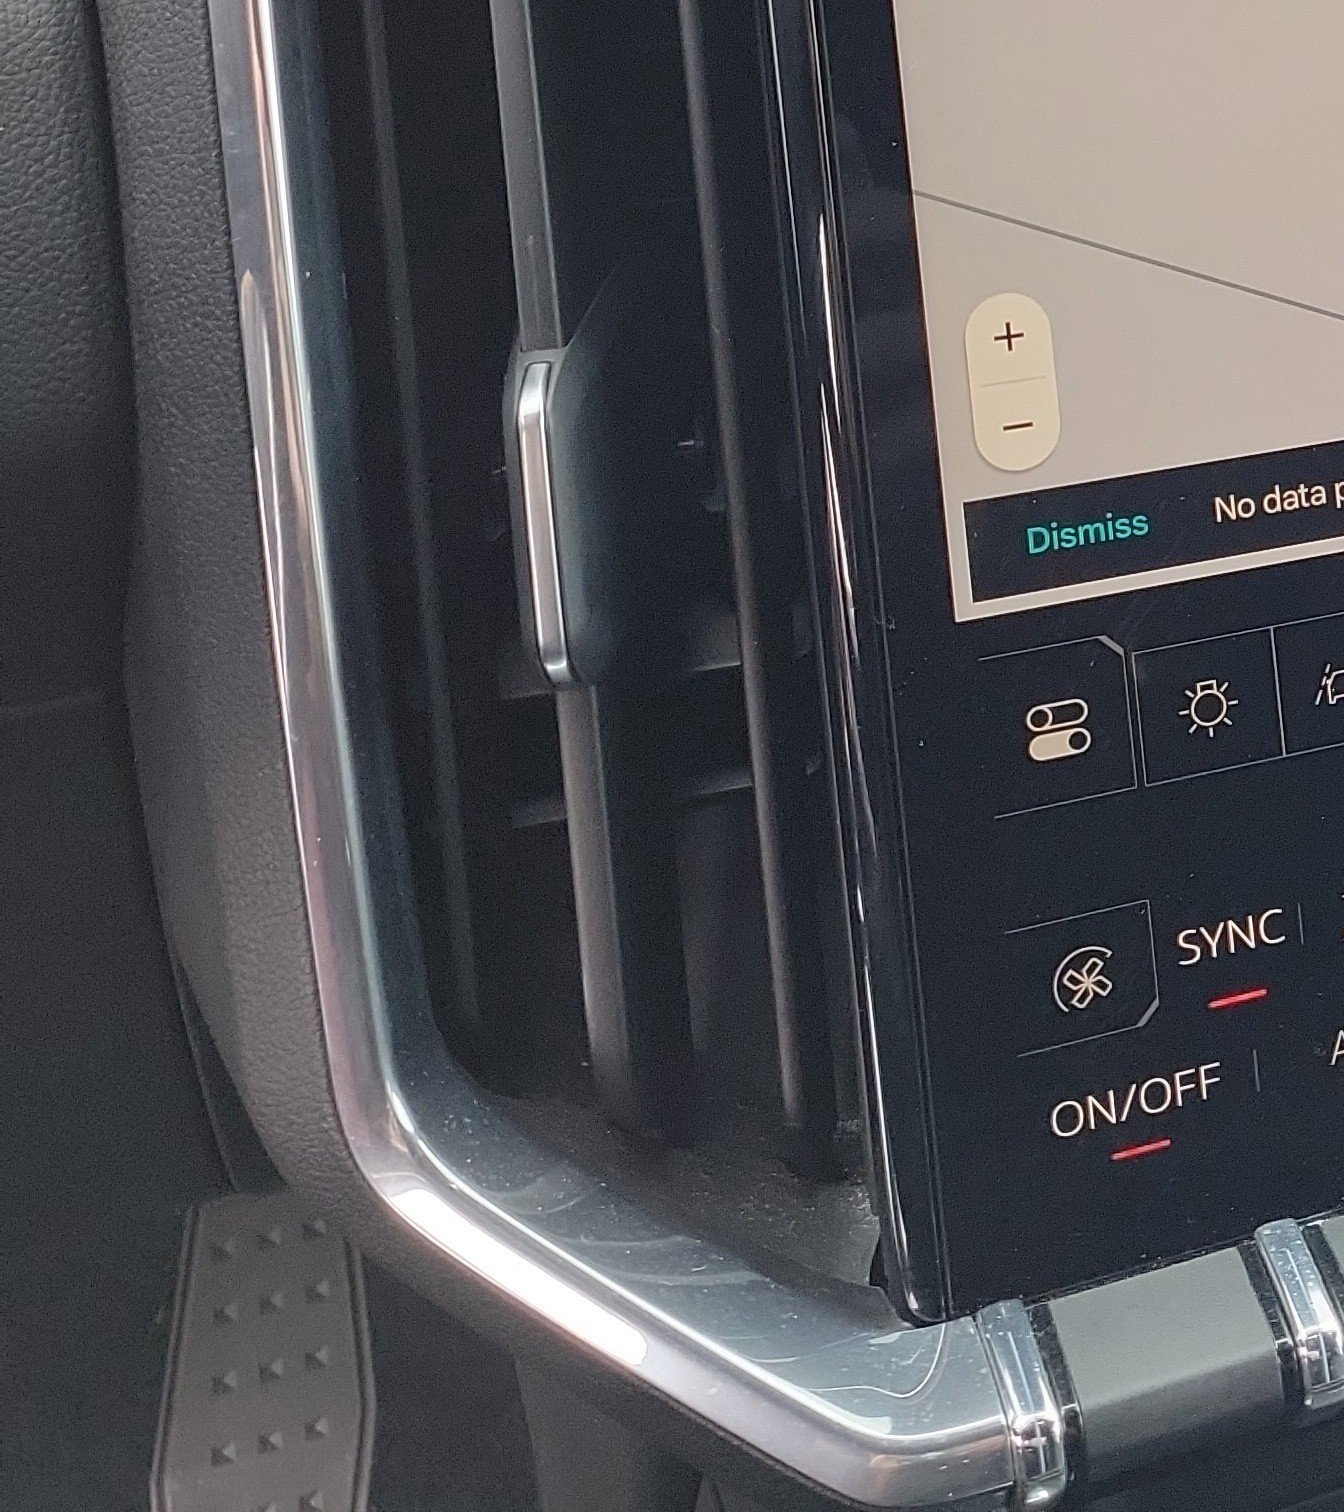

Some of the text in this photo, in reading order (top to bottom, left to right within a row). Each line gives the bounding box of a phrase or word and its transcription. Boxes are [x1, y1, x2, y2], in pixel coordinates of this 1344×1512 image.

[1214, 494, 1256, 523] No
[1263, 484, 1326, 513] data
[1026, 512, 1150, 556] Dismiss
[1177, 908, 1287, 966] SYNC
[1050, 1061, 1222, 1138] ON/OFF
